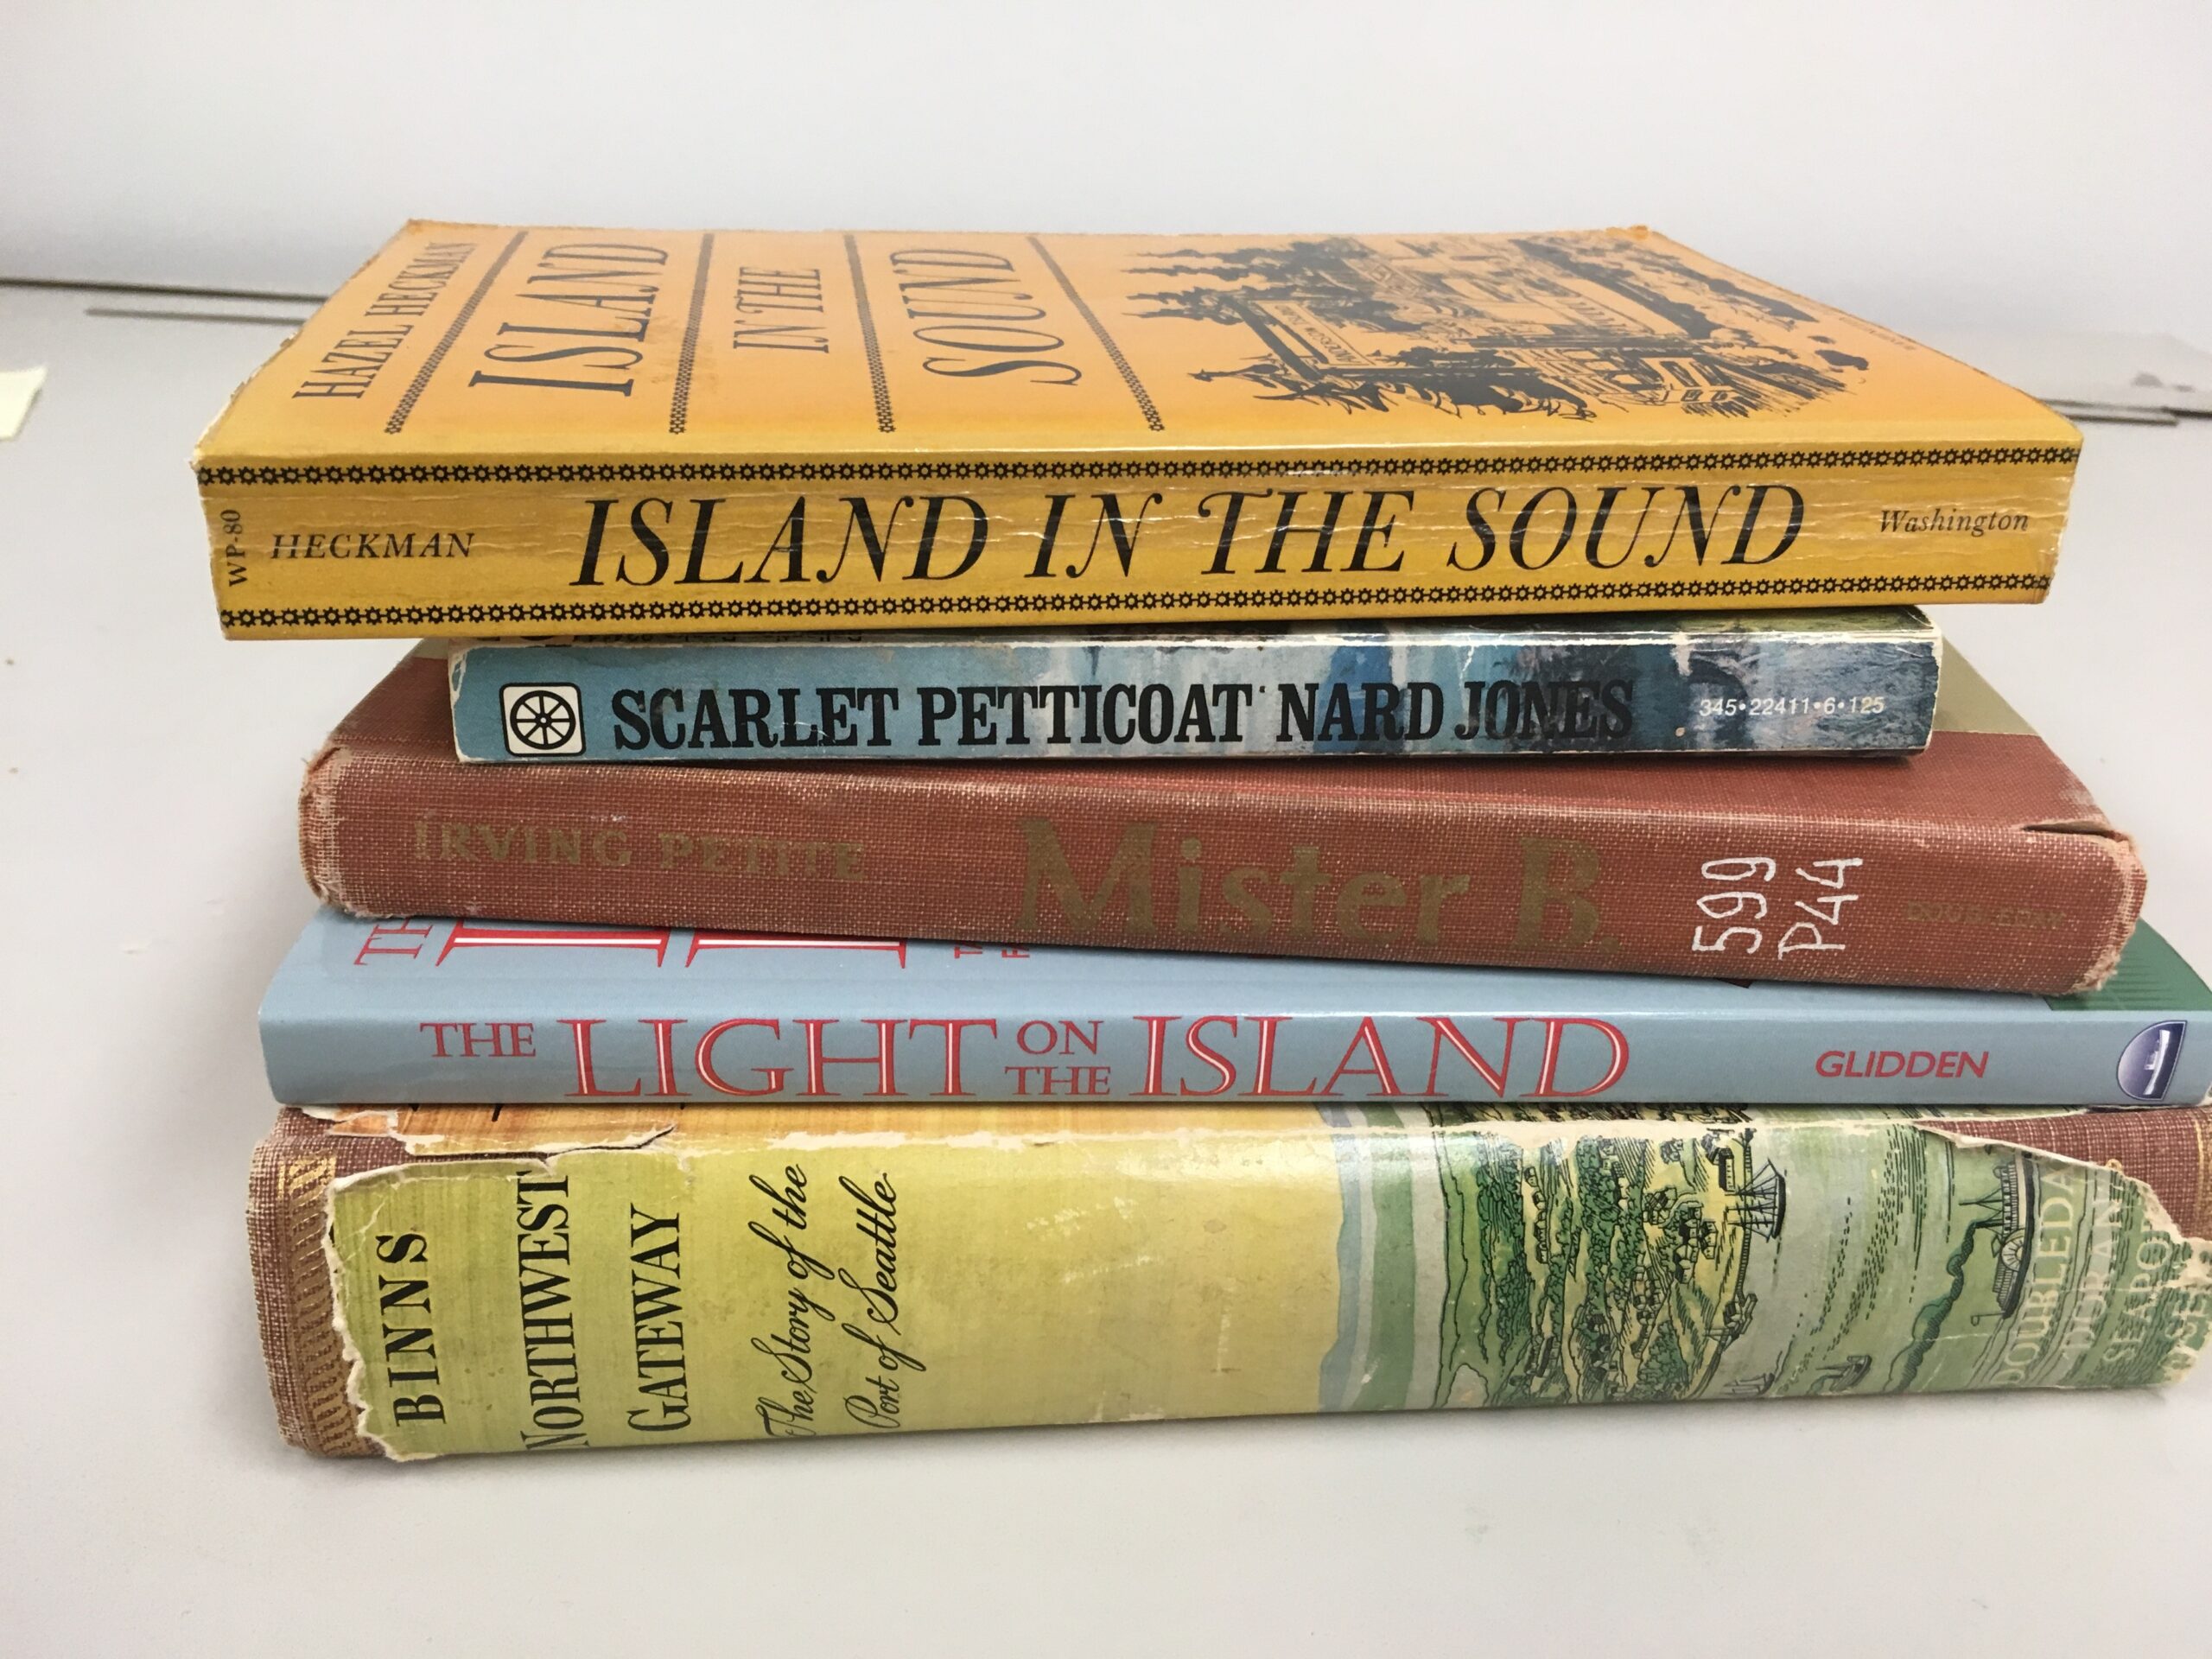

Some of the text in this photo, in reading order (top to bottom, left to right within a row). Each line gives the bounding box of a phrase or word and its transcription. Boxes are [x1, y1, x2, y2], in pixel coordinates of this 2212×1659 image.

[292, 242, 478, 399] HAZEL HECKMAN
[467, 243, 669, 397] ISLAND
[733, 266, 830, 353] IN THE
[889, 248, 1083, 386] SOUND
[219, 509, 249, 587] WP-80
[270, 532, 475, 560] HECKMAN
[569, 484, 1804, 587] ISLAND IN THE SOUND
[1880, 507, 2030, 538] Washington
[611, 678, 1634, 750] SCARLET PETTICOAT NARD JONES
[414, 818, 865, 881] IRVING PETITE
[1014, 819, 1471, 947] Mister
[1516, 835, 1624, 955] B.
[1691, 856, 1777, 954] 599
[1777, 857, 1864, 960] P44
[418, 1019, 997, 1098] THE LIGHT
[1004, 1065, 1112, 1096] THE
[1016, 1020, 1103, 1055] ON
[1132, 1016, 1630, 1098] ISLAND
[1815, 1049, 1989, 1078] GLIDDEN
[516, 1170, 589, 1450] NORTHWEST
[626, 1202, 692, 1432] GATEWAY
[747, 1163, 836, 1438] The Story of the
[837, 1172, 926, 1429] Port of Seattle
[1987, 1166, 2075, 1383] DOUBLEDA
[376, 1233, 447, 1427] BINNS
